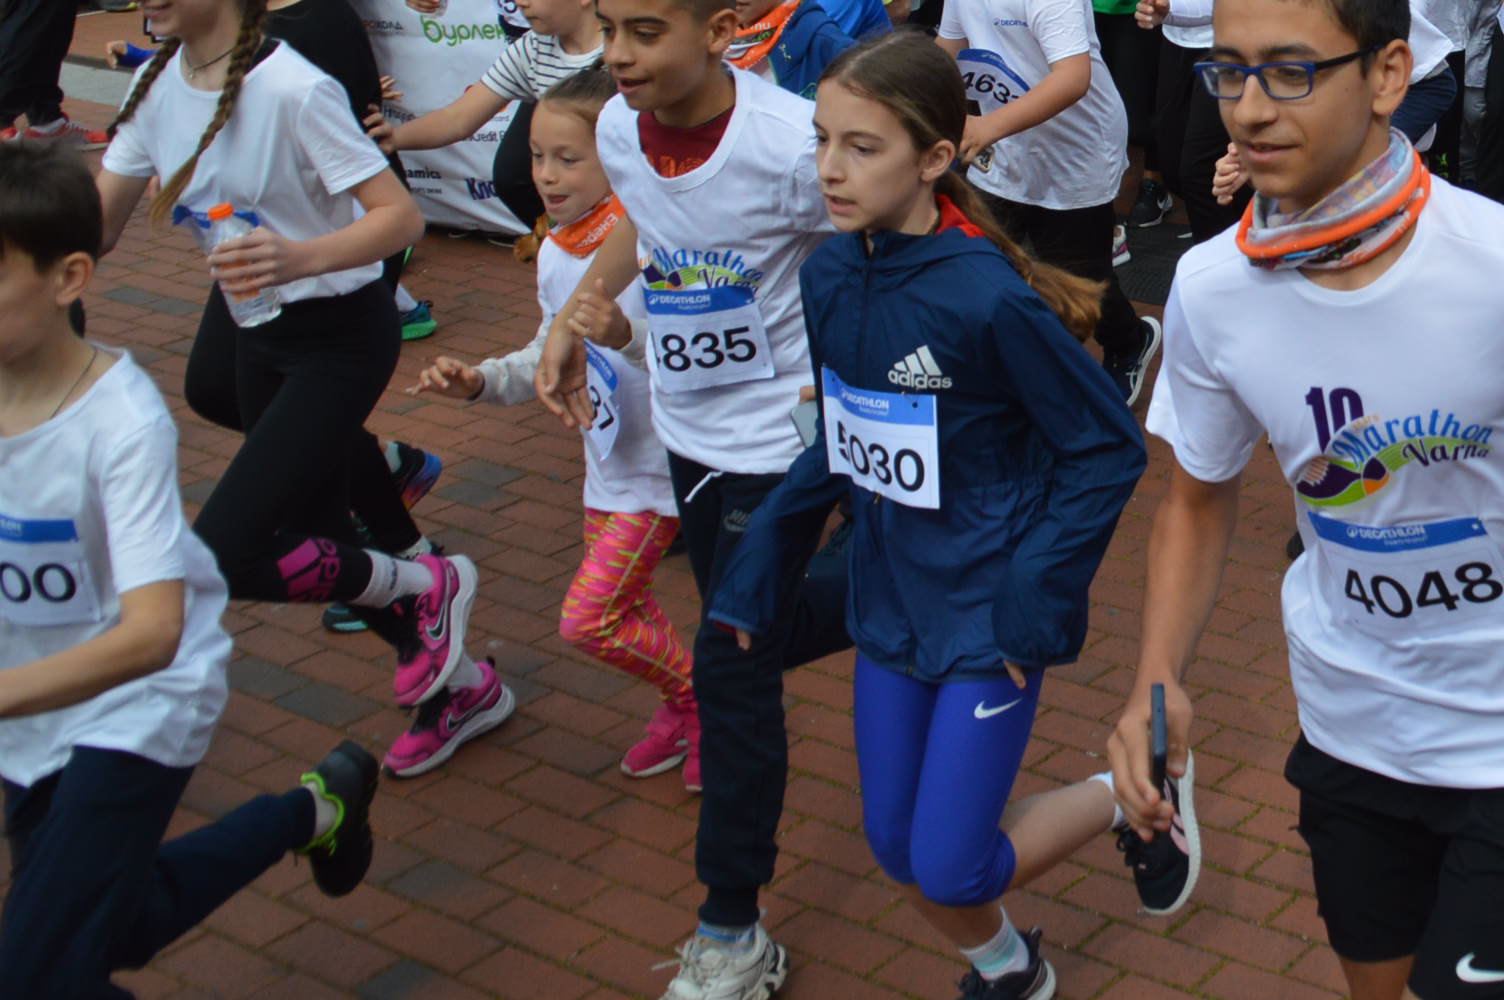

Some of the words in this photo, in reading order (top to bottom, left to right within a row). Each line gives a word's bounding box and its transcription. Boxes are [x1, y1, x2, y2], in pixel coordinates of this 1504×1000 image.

[962, 71, 1020, 105] 463
[660, 294, 711, 305] DECATHLON
[651, 326, 757, 373] 835
[888, 368, 953, 389] adidas
[1305, 386, 1364, 453] 10
[1332, 408, 1493, 469] Marathon
[1402, 439, 1489, 467] Varna
[1359, 525, 1426, 540] DECATHLON
[1345, 561, 1504, 619] 4048
